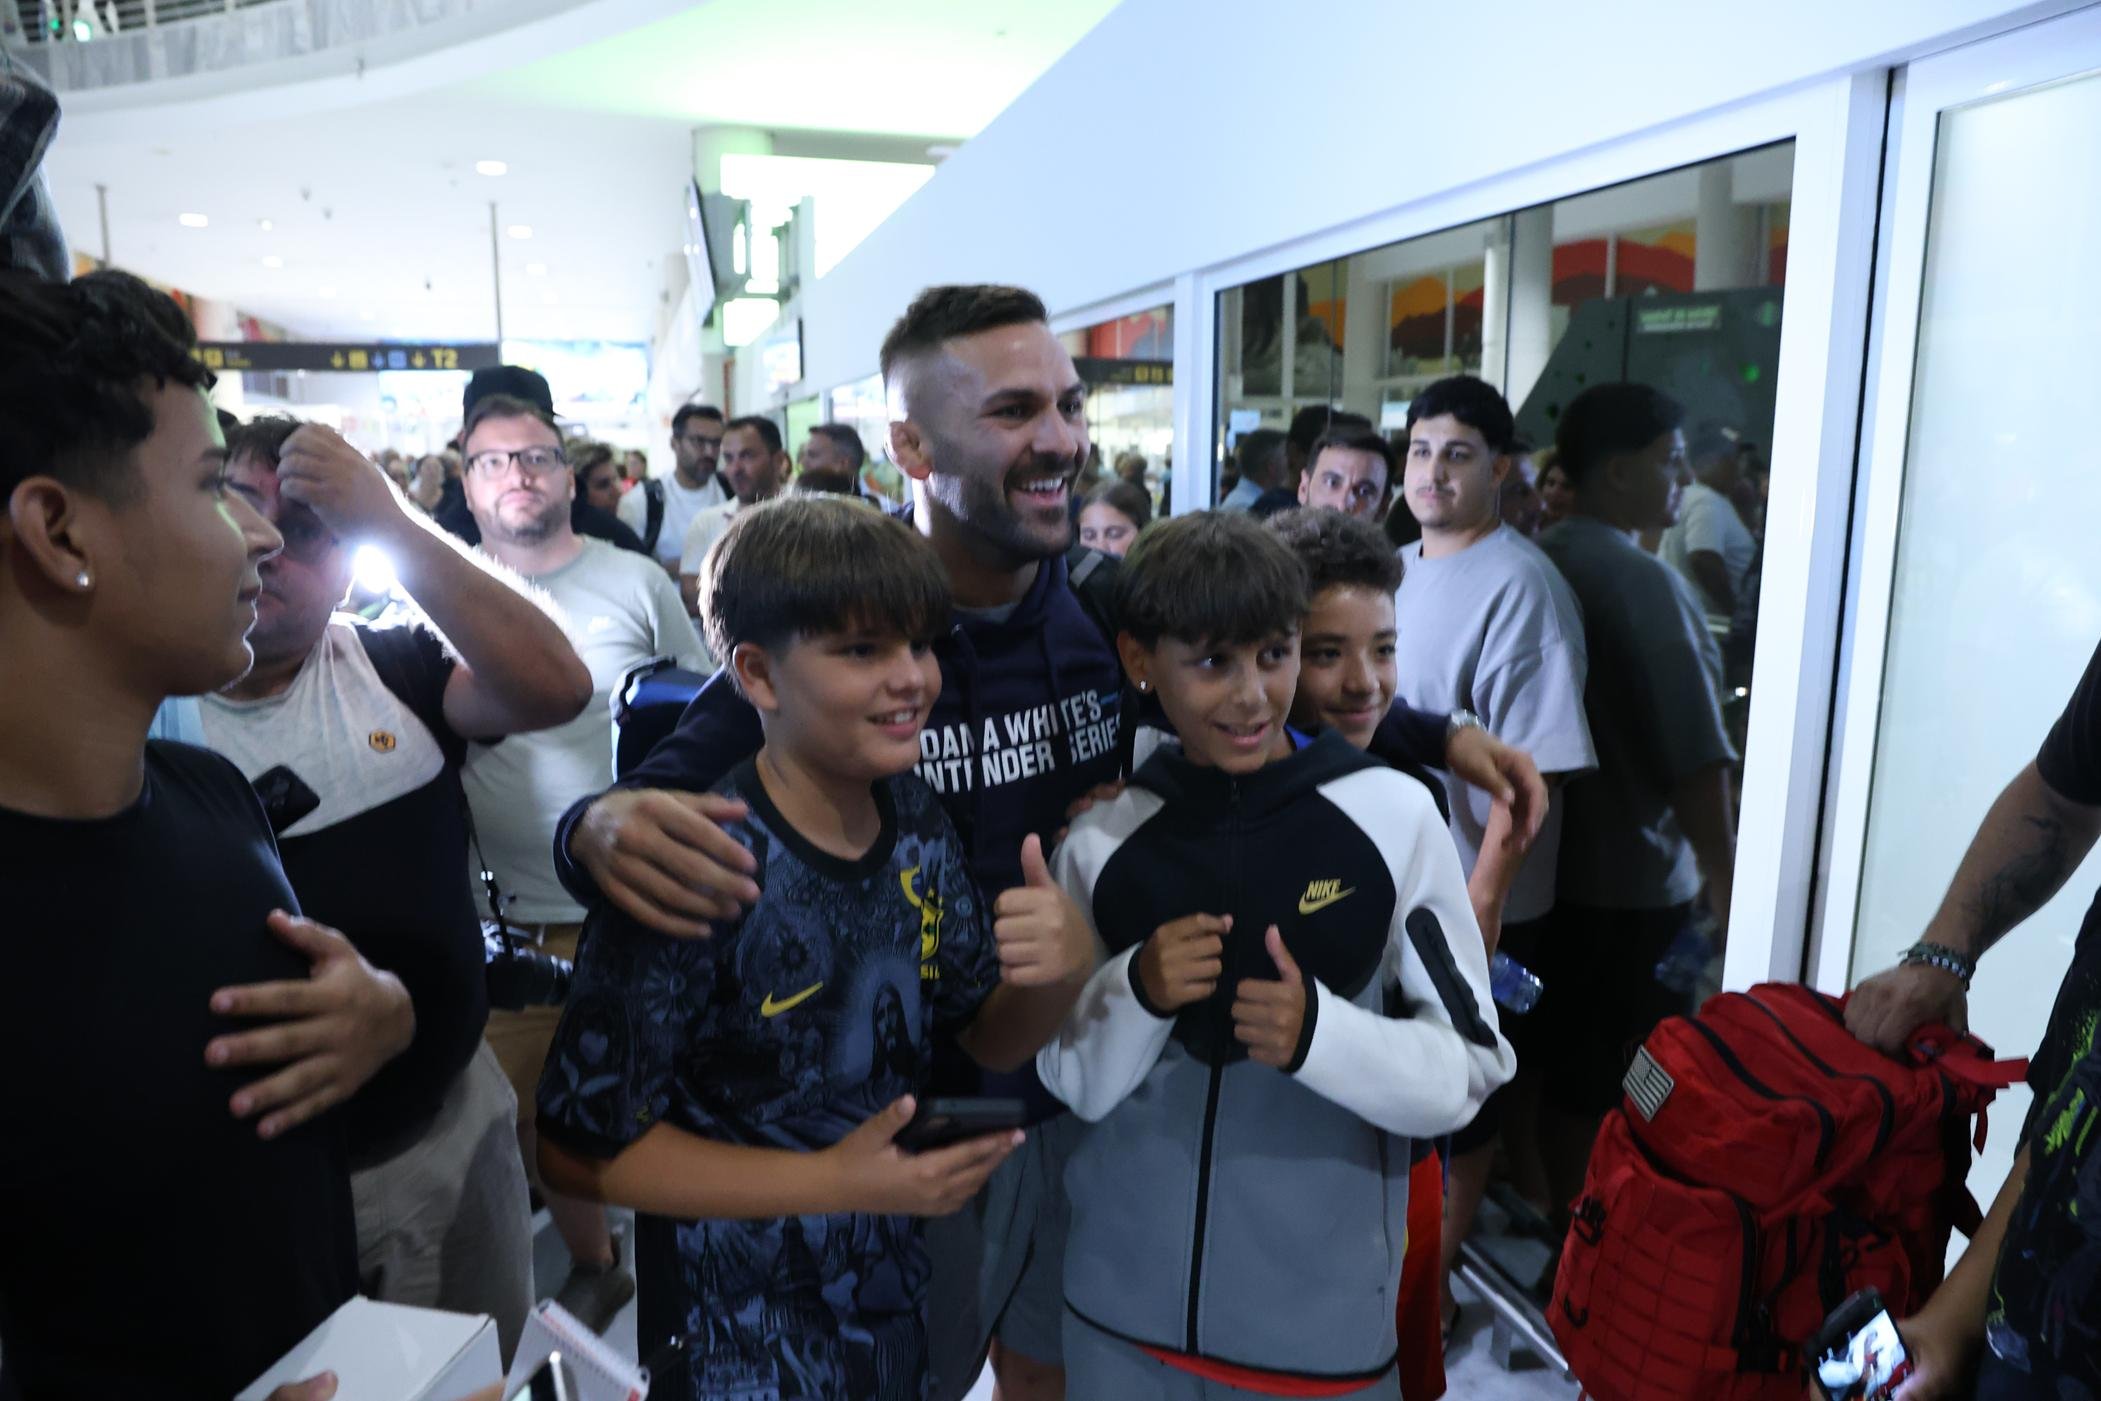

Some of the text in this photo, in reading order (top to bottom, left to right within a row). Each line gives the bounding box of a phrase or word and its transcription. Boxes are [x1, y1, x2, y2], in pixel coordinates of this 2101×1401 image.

[430, 349, 458, 369] T2
[1004, 689, 1101, 746] WHITE'S
[1306, 879, 1341, 900] NIKE
